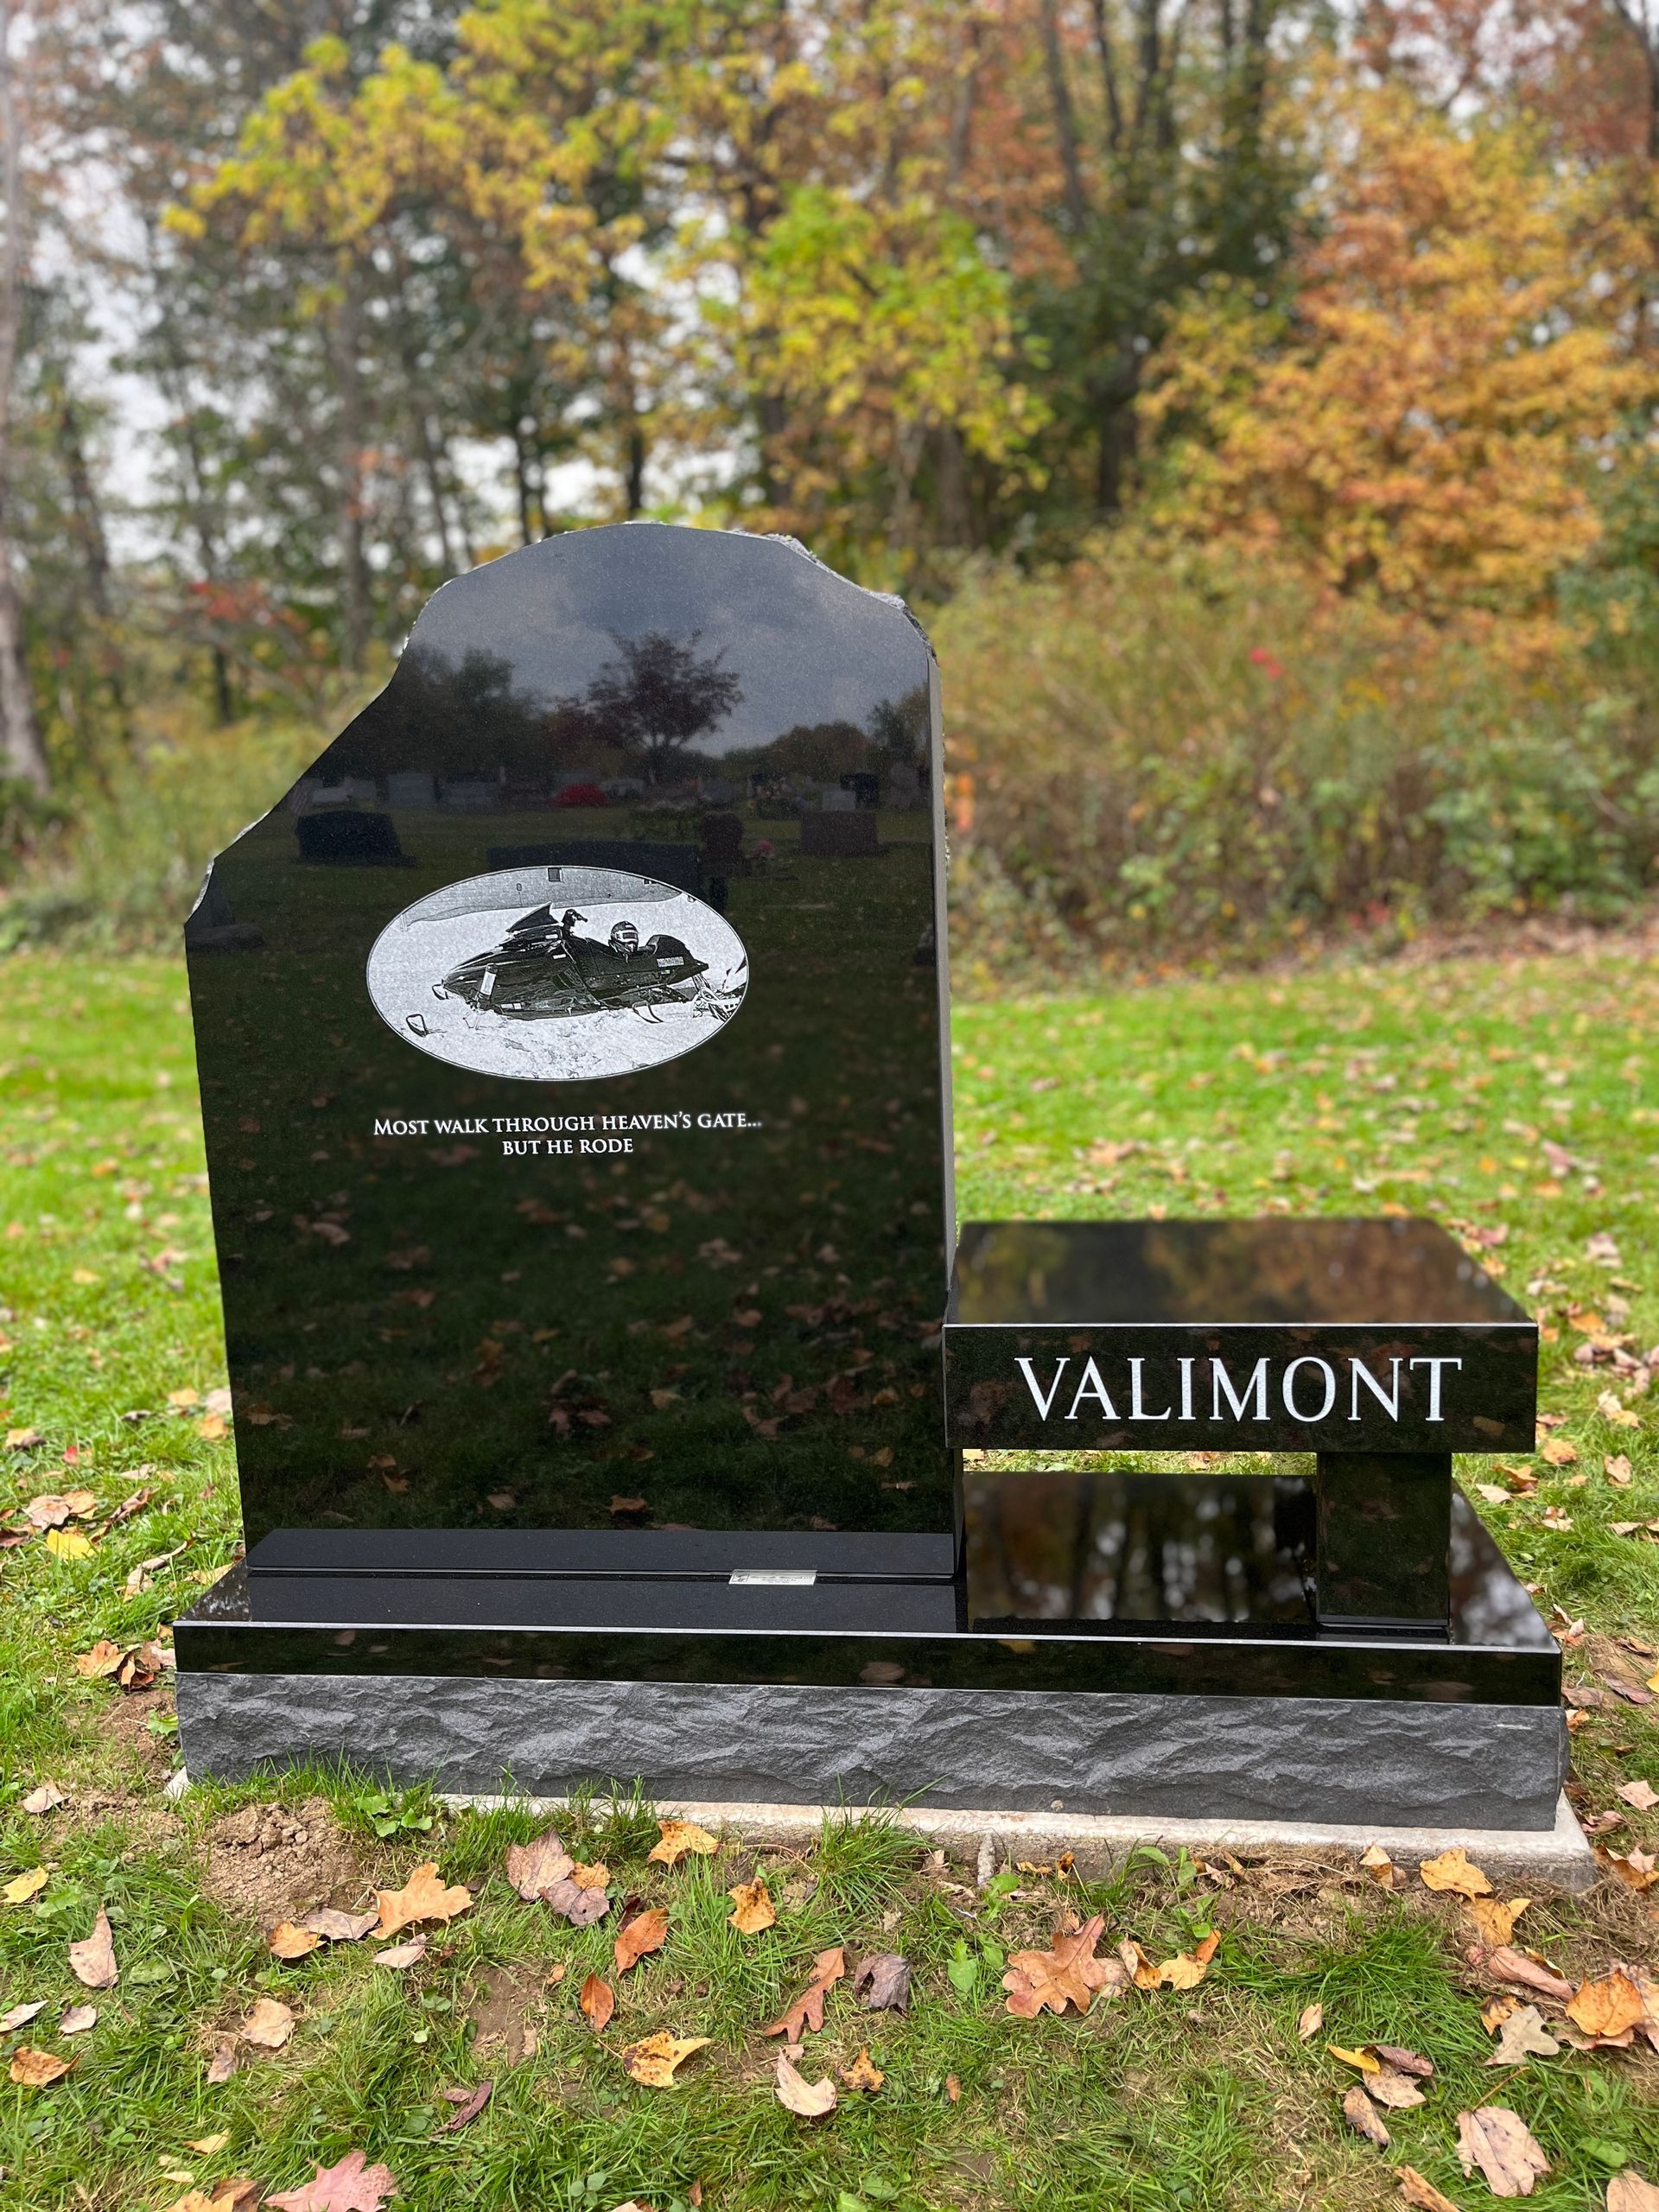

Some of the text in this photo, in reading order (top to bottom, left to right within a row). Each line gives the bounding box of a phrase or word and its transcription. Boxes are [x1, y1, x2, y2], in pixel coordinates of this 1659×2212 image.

[373, 1111, 762, 1135] MOST WALK THROUGH HEAVEN'S GATE...
[501, 1138, 634, 1155] BUT HE RODE
[1014, 1355, 1463, 1422] VALIMONT
